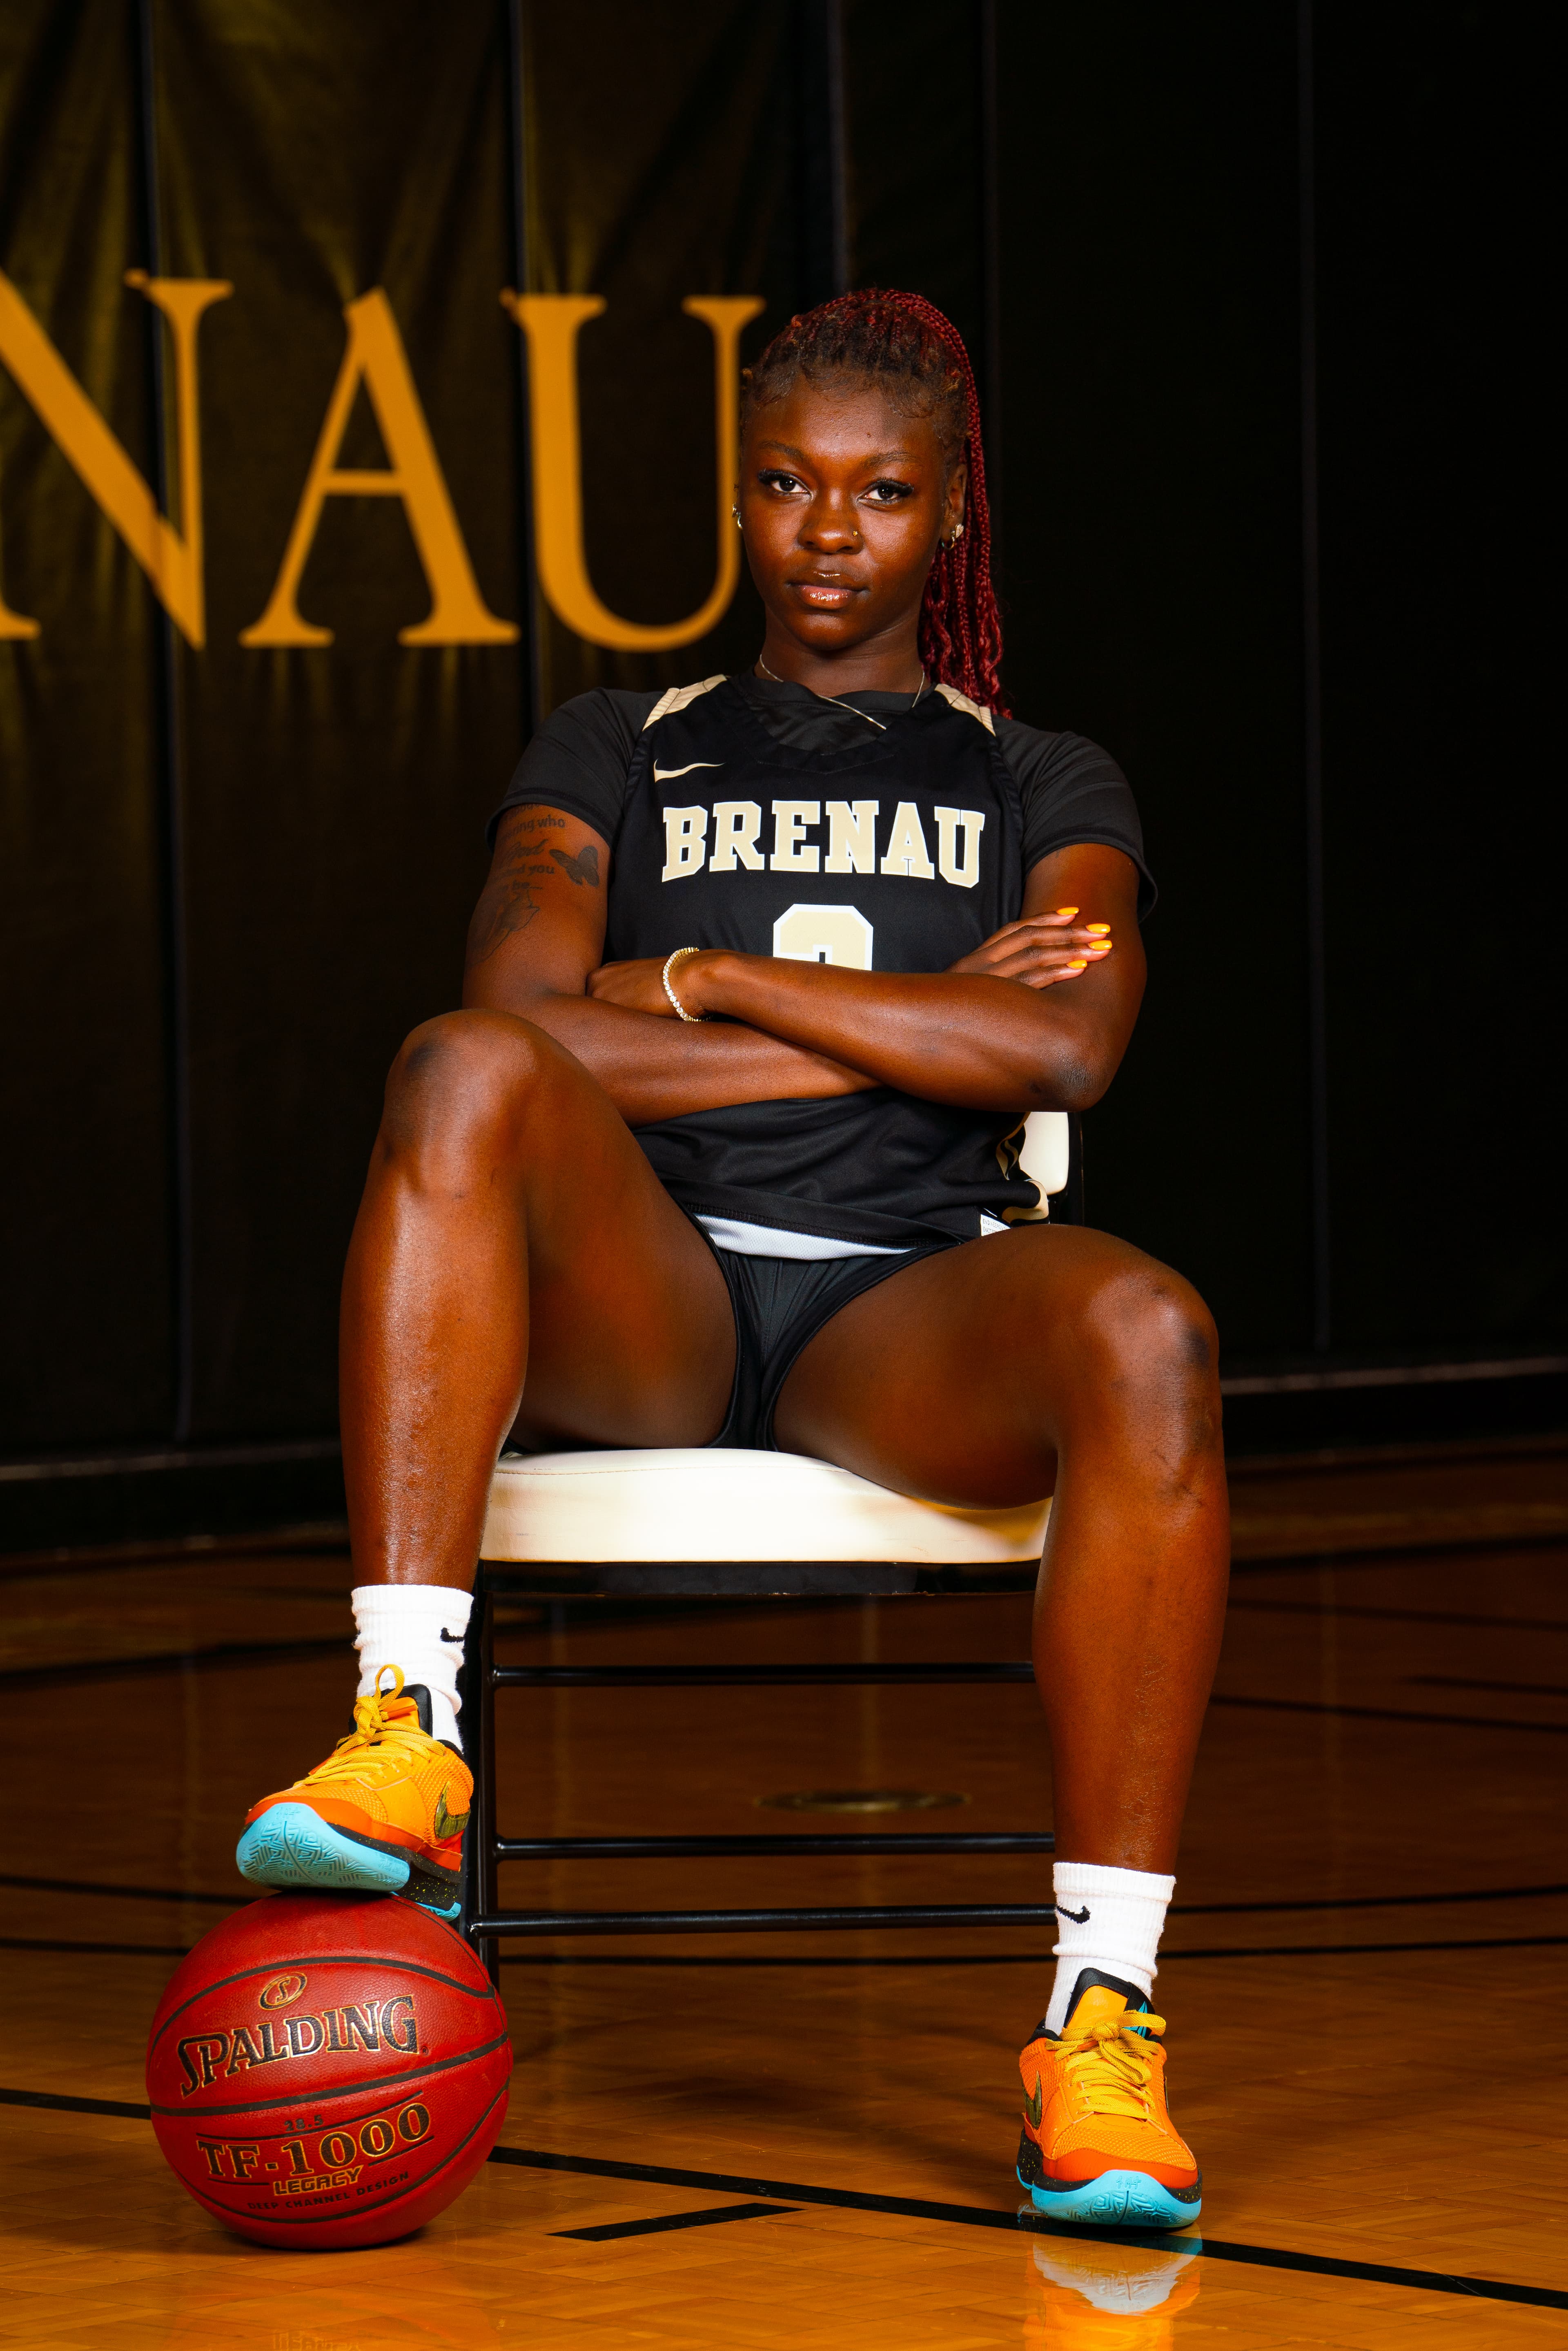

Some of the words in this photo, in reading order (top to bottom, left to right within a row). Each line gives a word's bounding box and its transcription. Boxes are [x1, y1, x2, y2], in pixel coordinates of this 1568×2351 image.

[537, 814, 566, 828] who
[662, 800, 985, 888] BRENAU
[176, 1995, 419, 2099] SPALDING
[196, 2102, 431, 2179] TF-1000
[284, 2115, 324, 2131] 28.5
[247, 2202, 279, 2210] DEEP
[285, 2192, 350, 2208] CHANNEL
[356, 2171, 410, 2196] DESIGN
[273, 2165, 364, 2195] LEGACY
